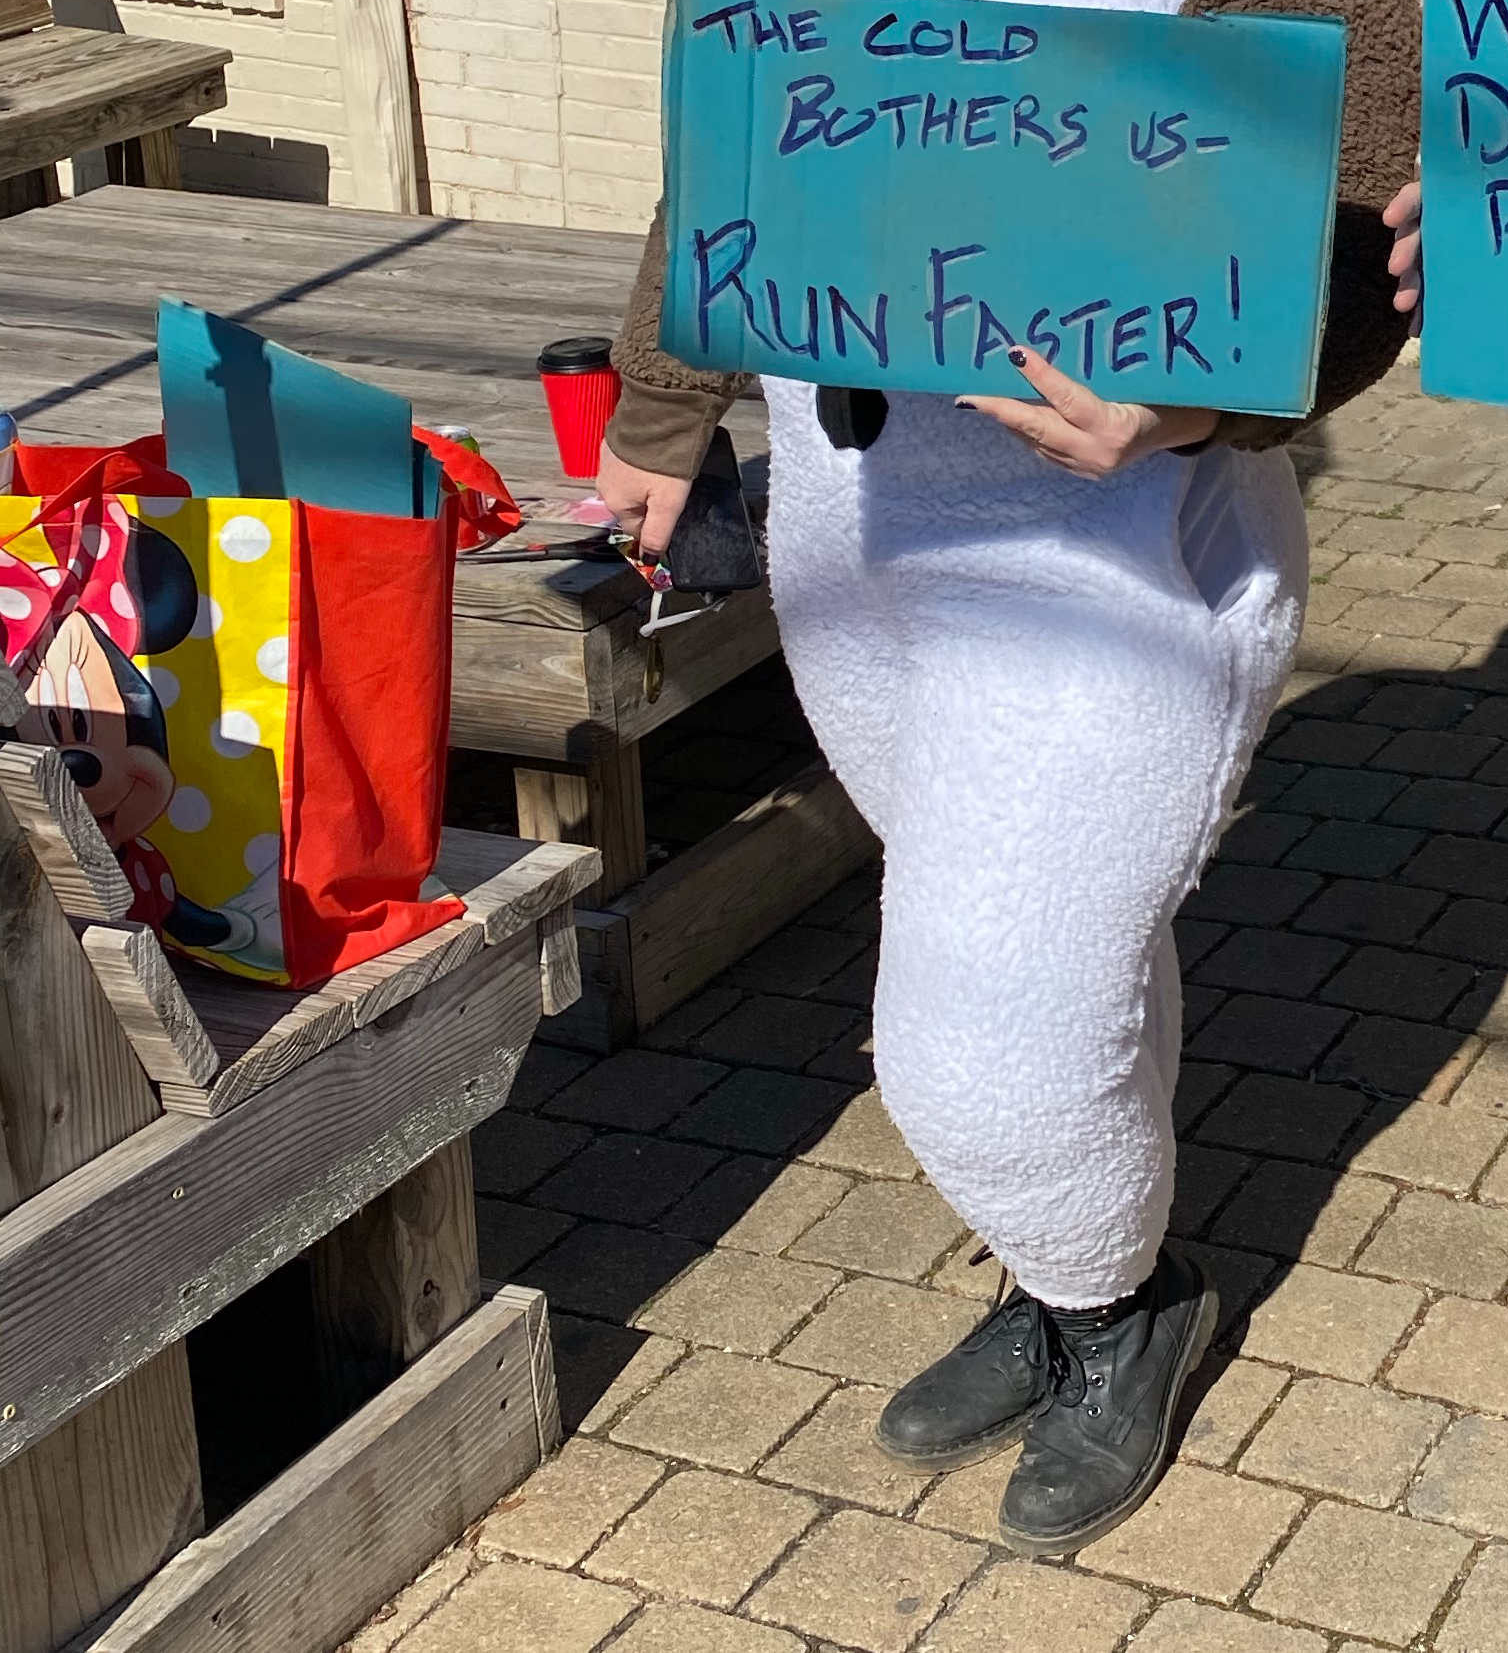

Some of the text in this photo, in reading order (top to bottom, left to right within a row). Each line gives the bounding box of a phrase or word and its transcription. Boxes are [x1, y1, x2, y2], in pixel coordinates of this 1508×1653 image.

[692, 0, 1038, 62] THE COLD
[779, 74, 1088, 162] BOTHERS
[693, 218, 1242, 378] RUN FASTER!
